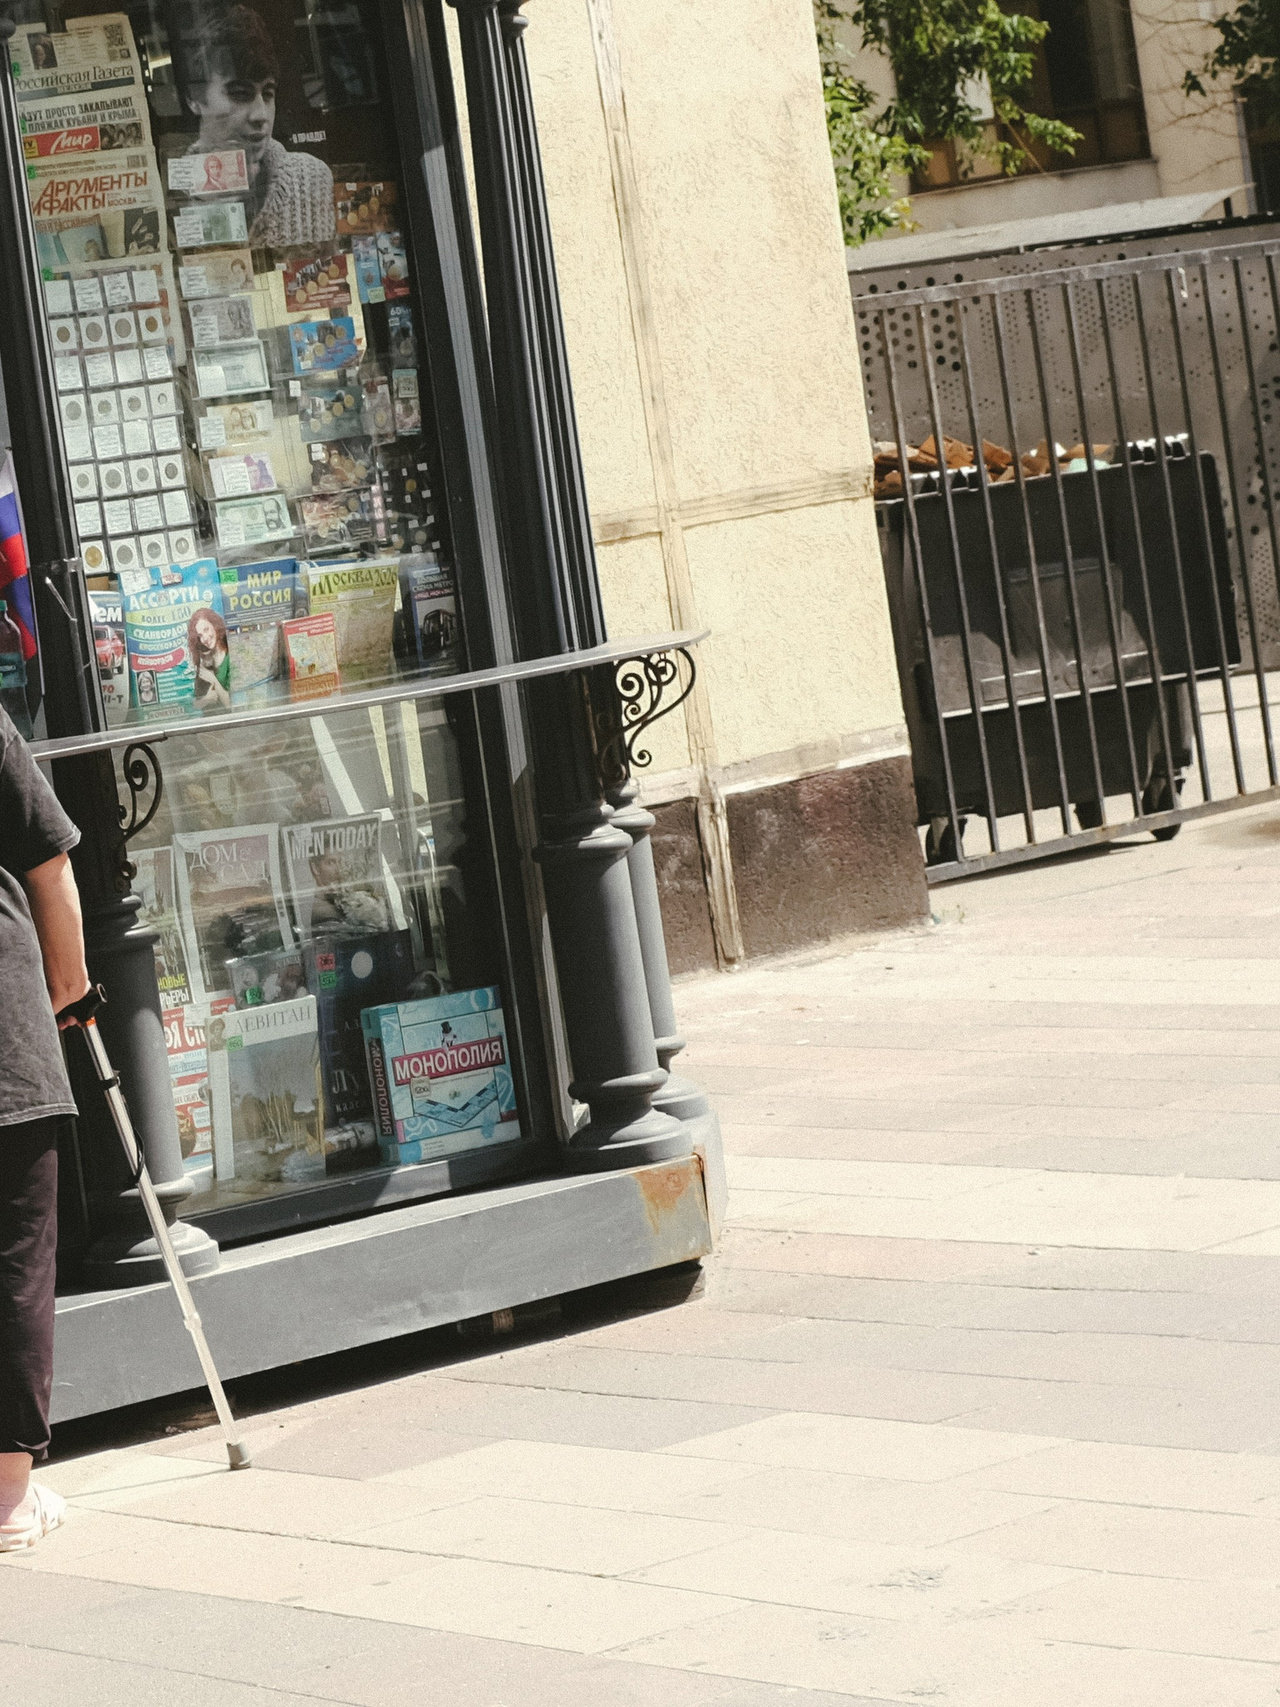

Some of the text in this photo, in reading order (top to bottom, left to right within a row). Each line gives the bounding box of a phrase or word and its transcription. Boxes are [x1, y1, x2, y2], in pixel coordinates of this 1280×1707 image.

[42, 171, 148, 198] АРГУМЕНТЫ
[247, 570, 282, 589] МИР
[229, 587, 291, 612] РОССИЯ
[326, 822, 379, 854] TODAY
[189, 842, 238, 872] ДОМ
[394, 1040, 503, 1081] МОНОПОЛИЯ
[369, 1040, 393, 1136] МОНОПОЛИЯ
